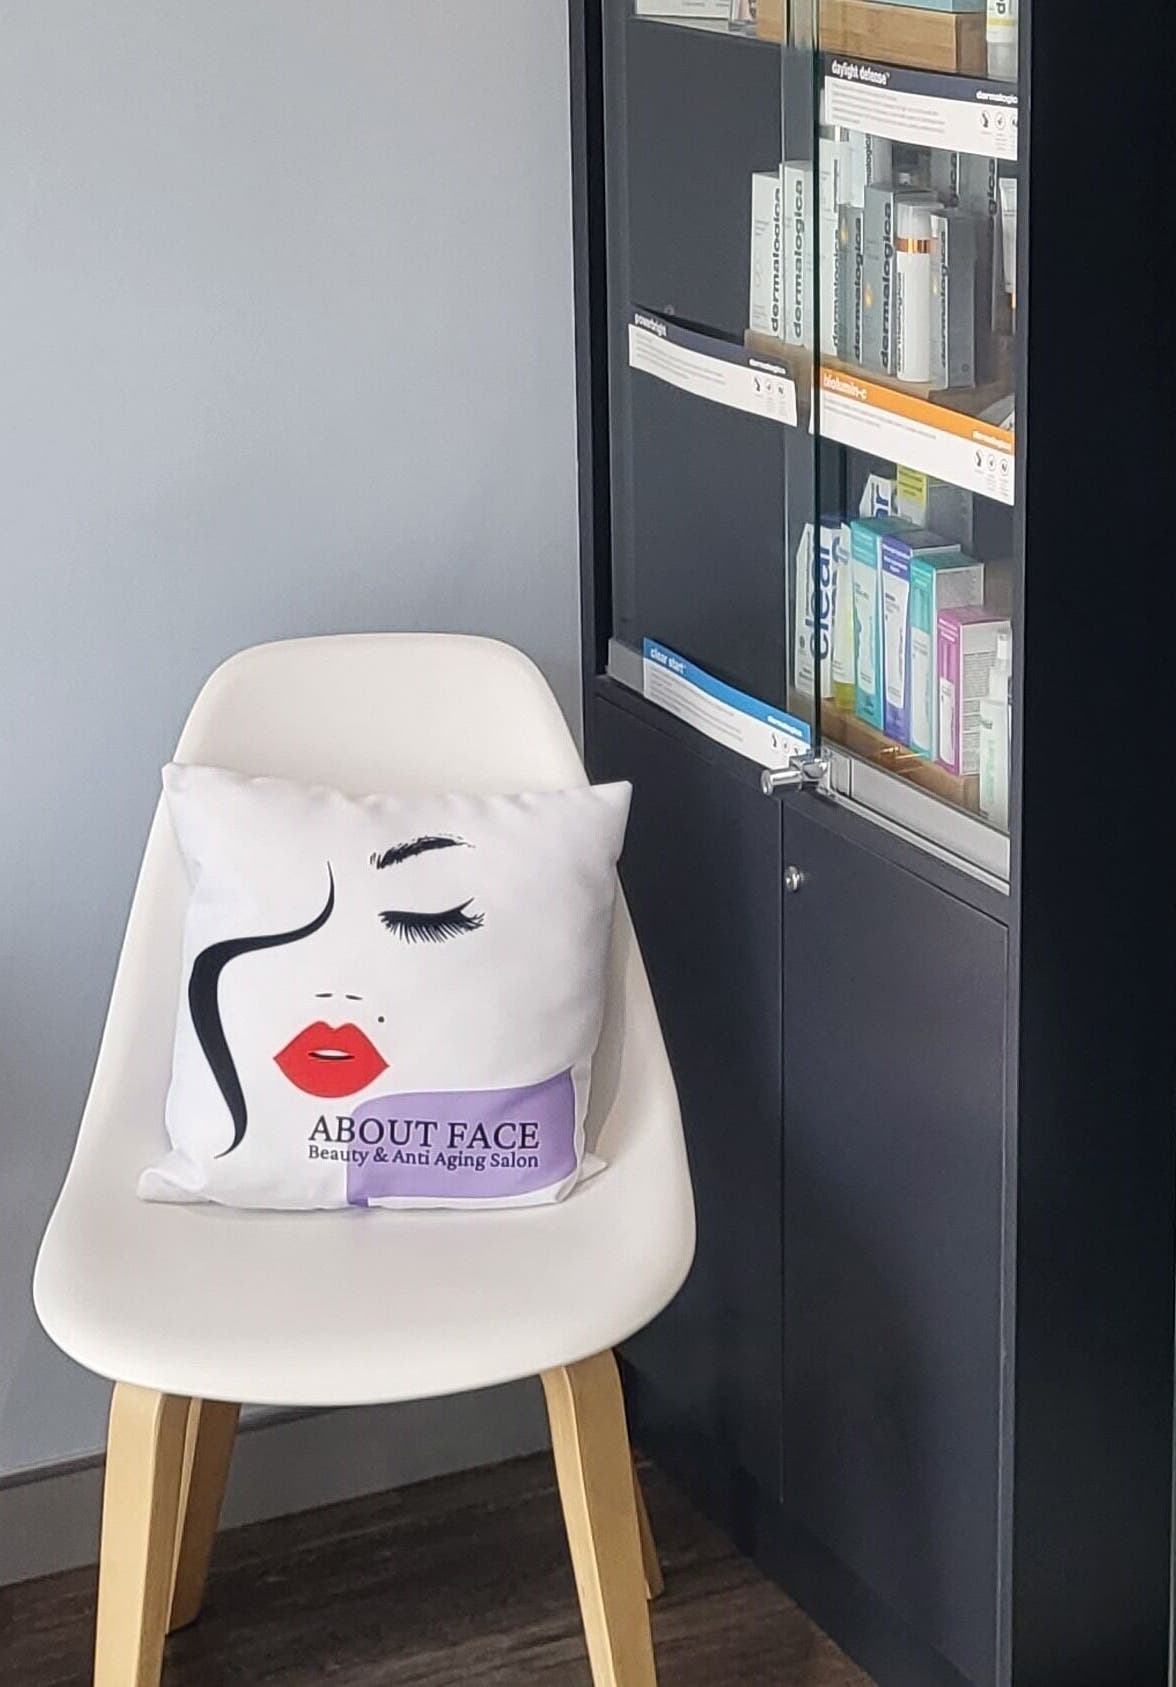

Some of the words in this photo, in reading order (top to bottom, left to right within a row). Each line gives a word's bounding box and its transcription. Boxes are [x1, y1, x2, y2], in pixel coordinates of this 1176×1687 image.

[793, 179, 805, 339] dermalogica
[308, 1115, 438, 1148] ABOUT
[447, 1122, 540, 1149] FACE
[308, 1144, 369, 1167] Beauty
[373, 1146, 388, 1163] &
[392, 1150, 430, 1165] Anti
[434, 1151, 486, 1171] Aging
[490, 1151, 539, 1168] Salon
